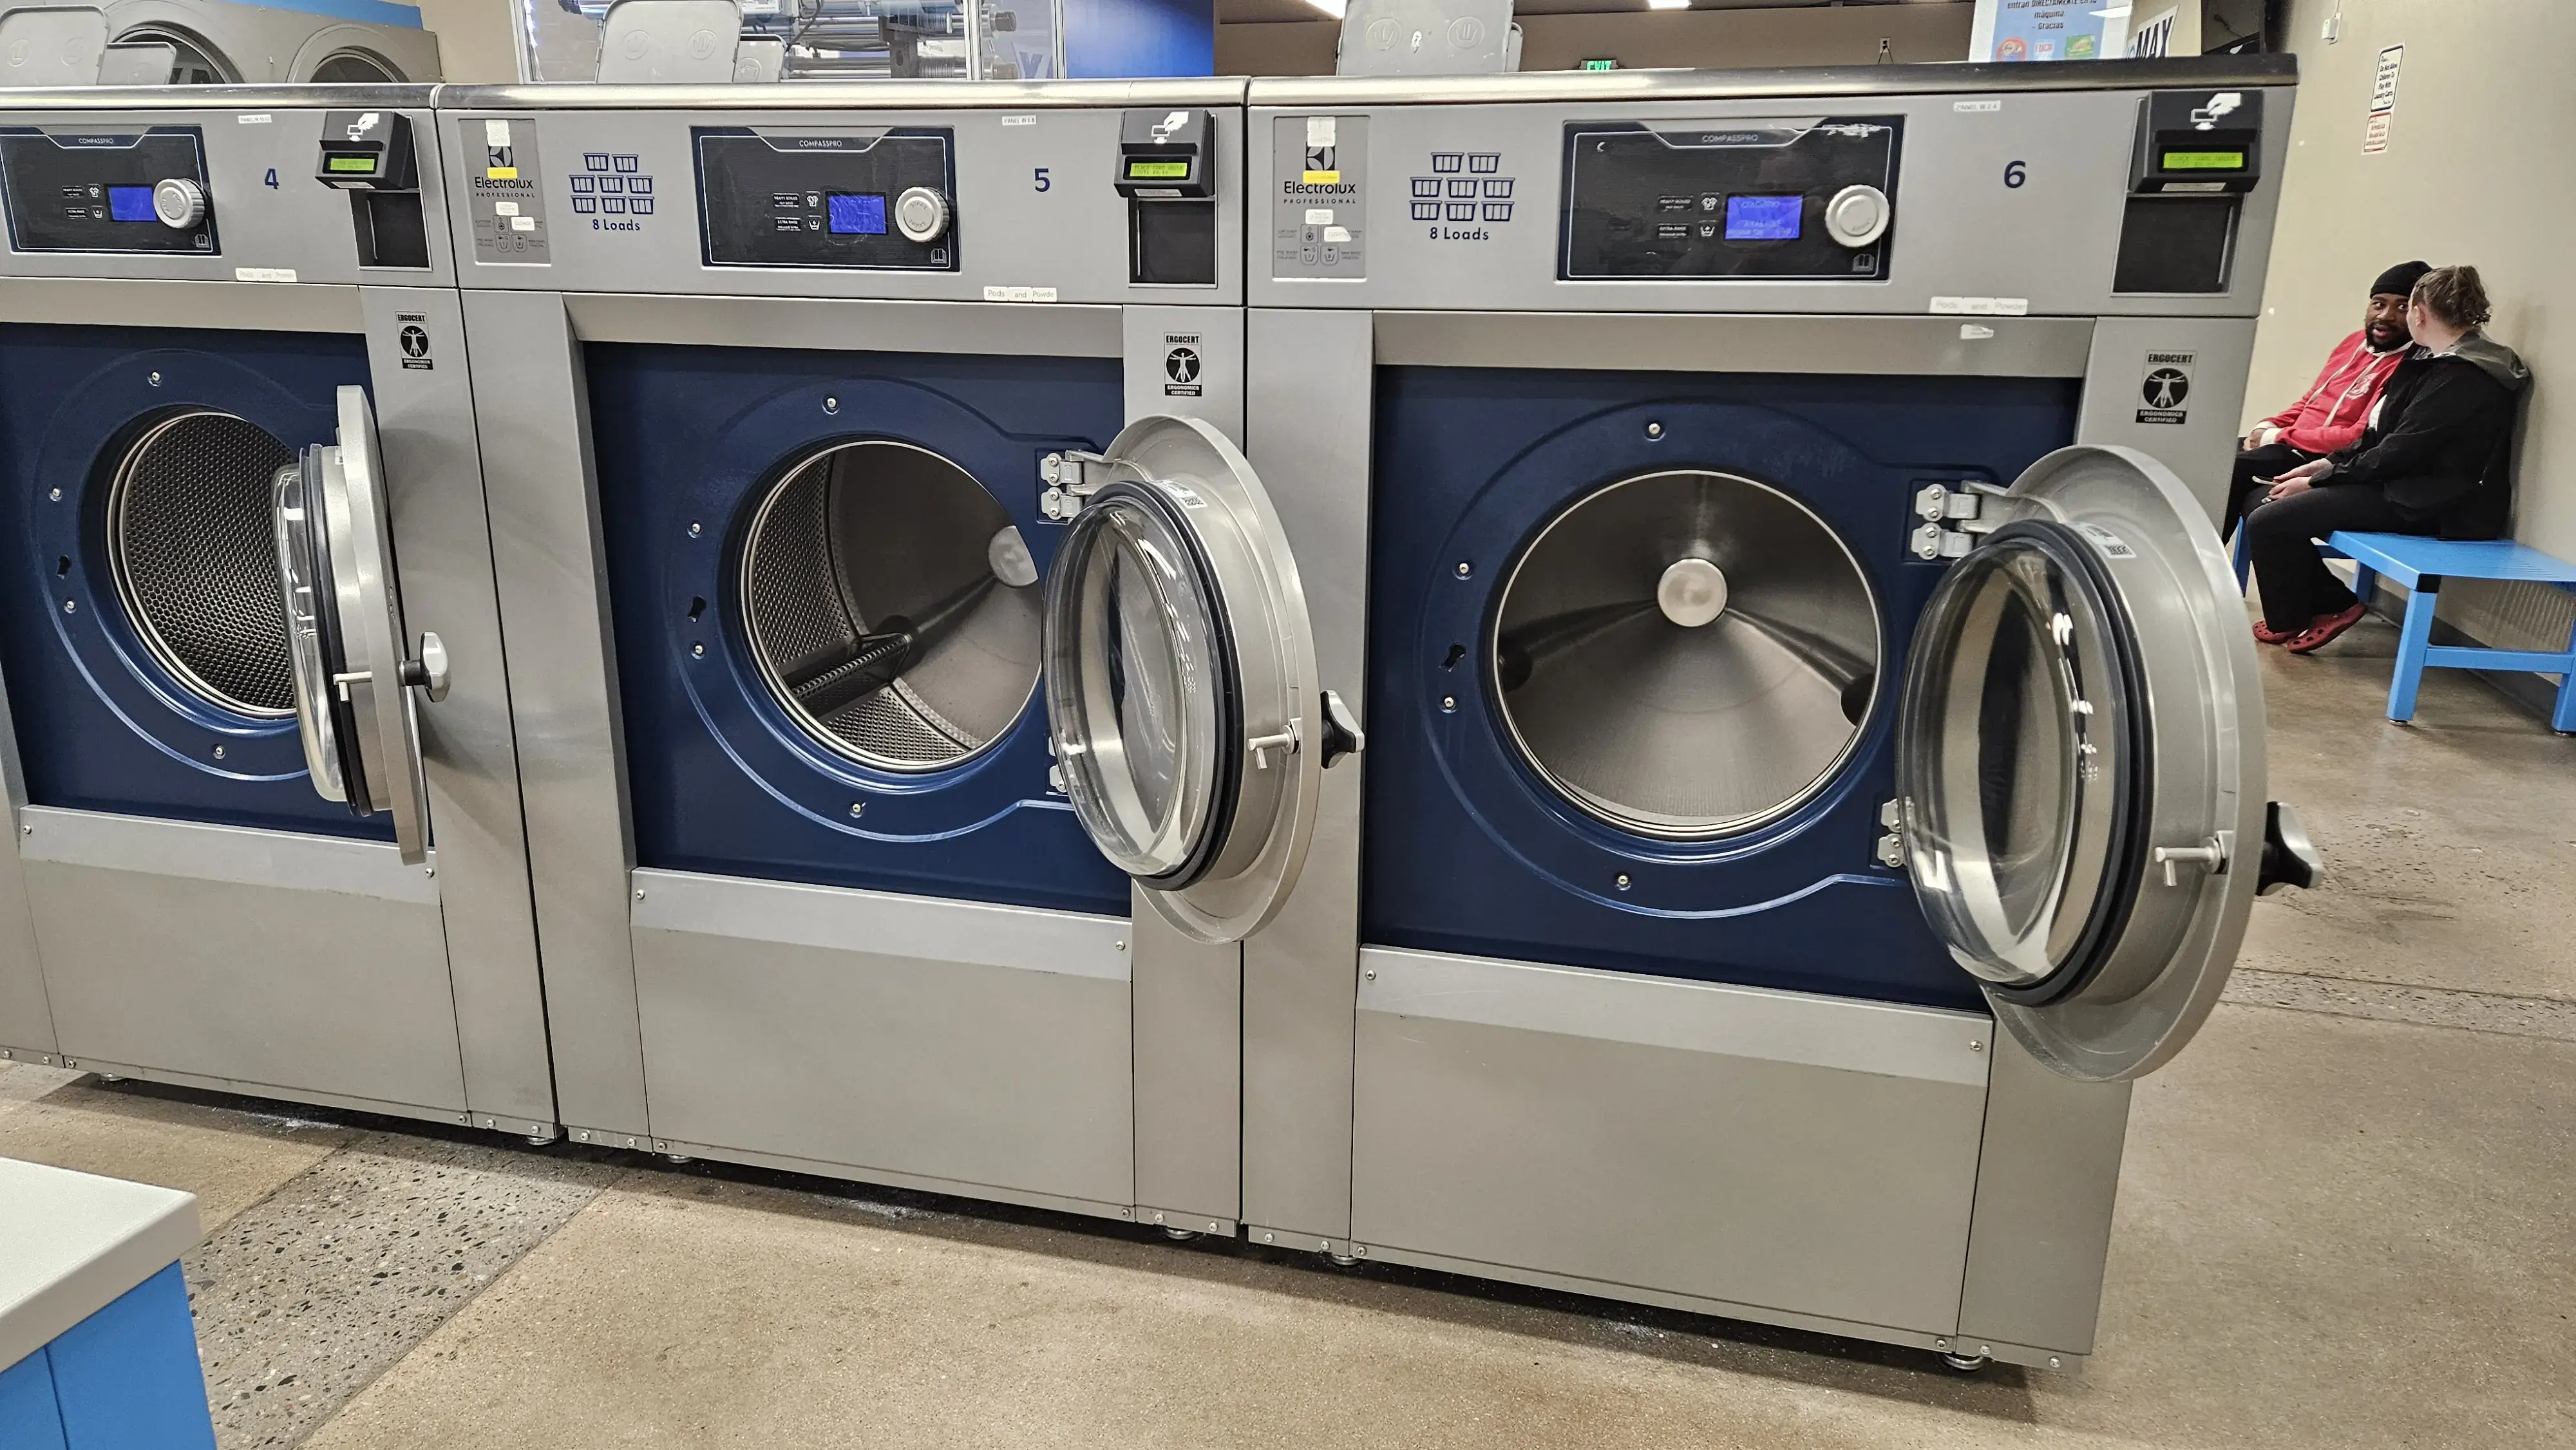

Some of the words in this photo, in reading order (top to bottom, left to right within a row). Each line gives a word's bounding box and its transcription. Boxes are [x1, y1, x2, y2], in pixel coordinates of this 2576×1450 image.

[1702, 134, 1759, 142] COMPASSPRO
[265, 169, 279, 189] 4
[1034, 168, 1050, 192] 5
[2004, 160, 2026, 187] 6
[475, 176, 534, 189] Electrolux
[1283, 181, 1356, 194] Electrolux
[592, 219, 600, 230] 8
[603, 219, 640, 231] Loads
[1430, 227, 1438, 240] 8
[1444, 227, 1489, 240] Loads
[2148, 353, 2194, 363] ERGOCERT
